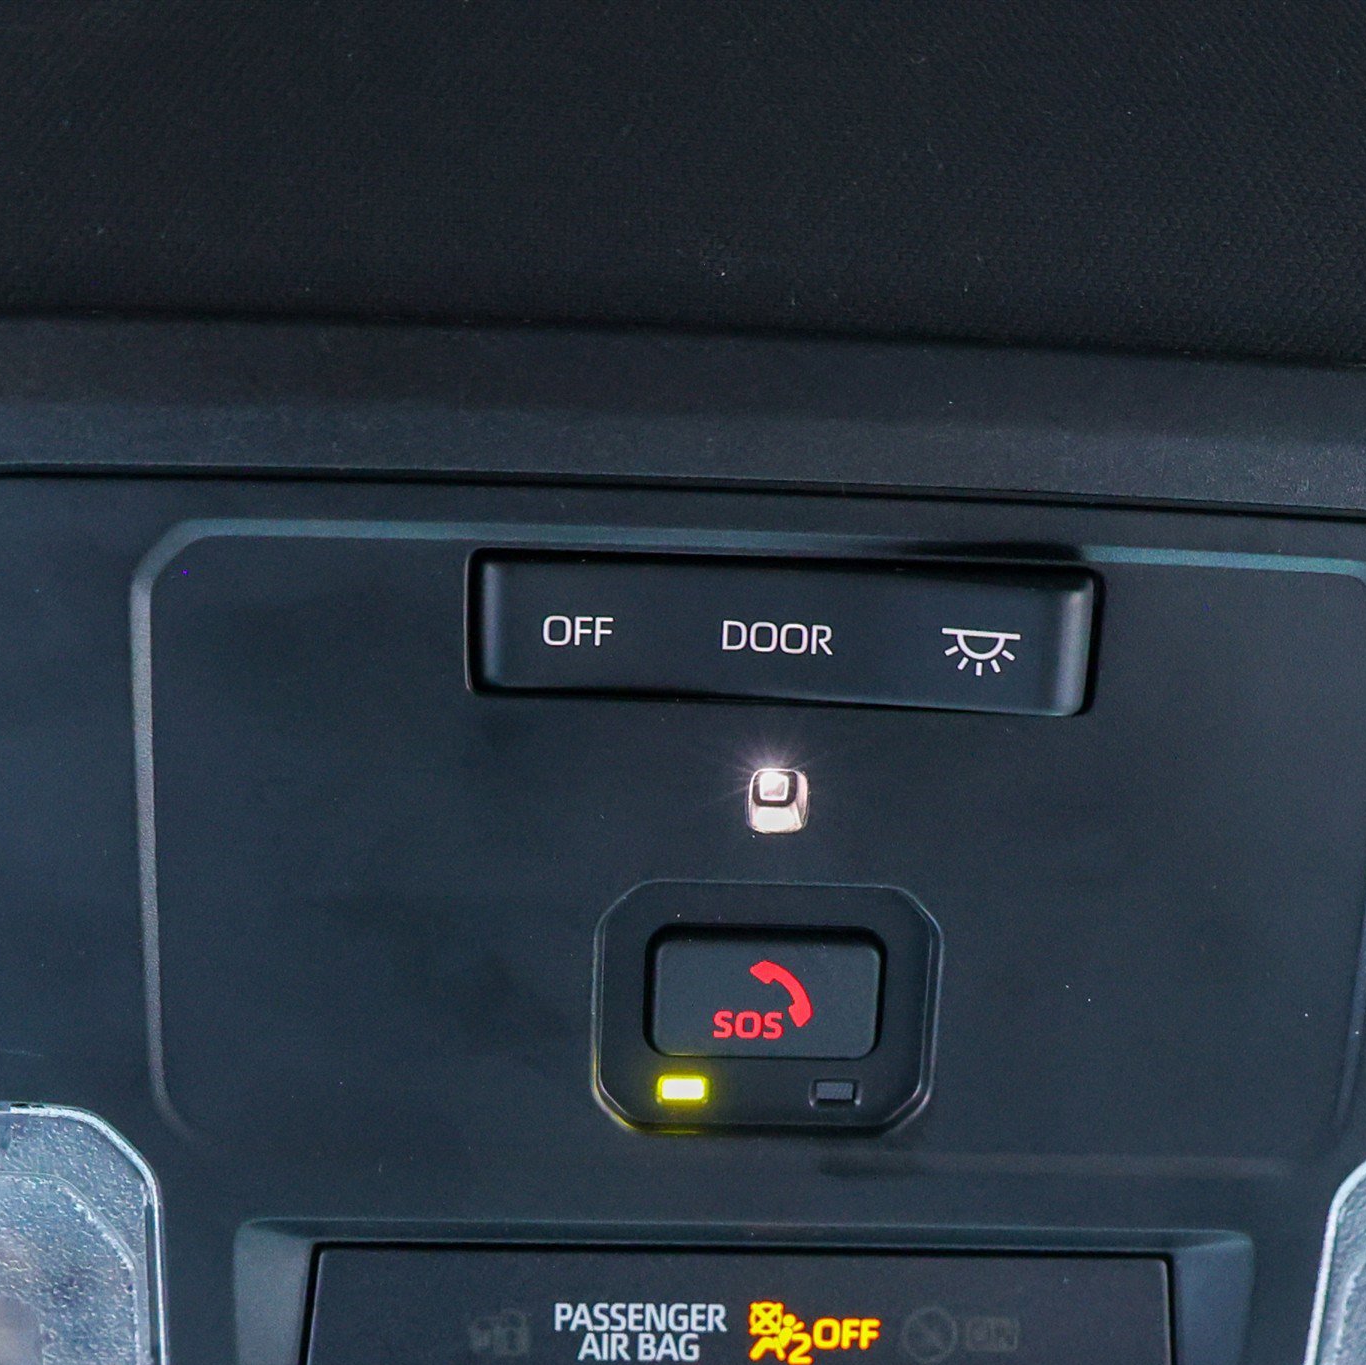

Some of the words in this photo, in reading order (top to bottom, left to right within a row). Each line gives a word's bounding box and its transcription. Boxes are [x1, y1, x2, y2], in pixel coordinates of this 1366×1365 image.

[542, 615, 614, 647] OFF
[721, 619, 833, 656] DOOR
[712, 1009, 784, 1040] SOS
[554, 1302, 727, 1332] PASSENGER
[578, 1333, 631, 1361] AIR
[637, 1333, 700, 1362] BAG
[812, 1317, 881, 1350] OFF
